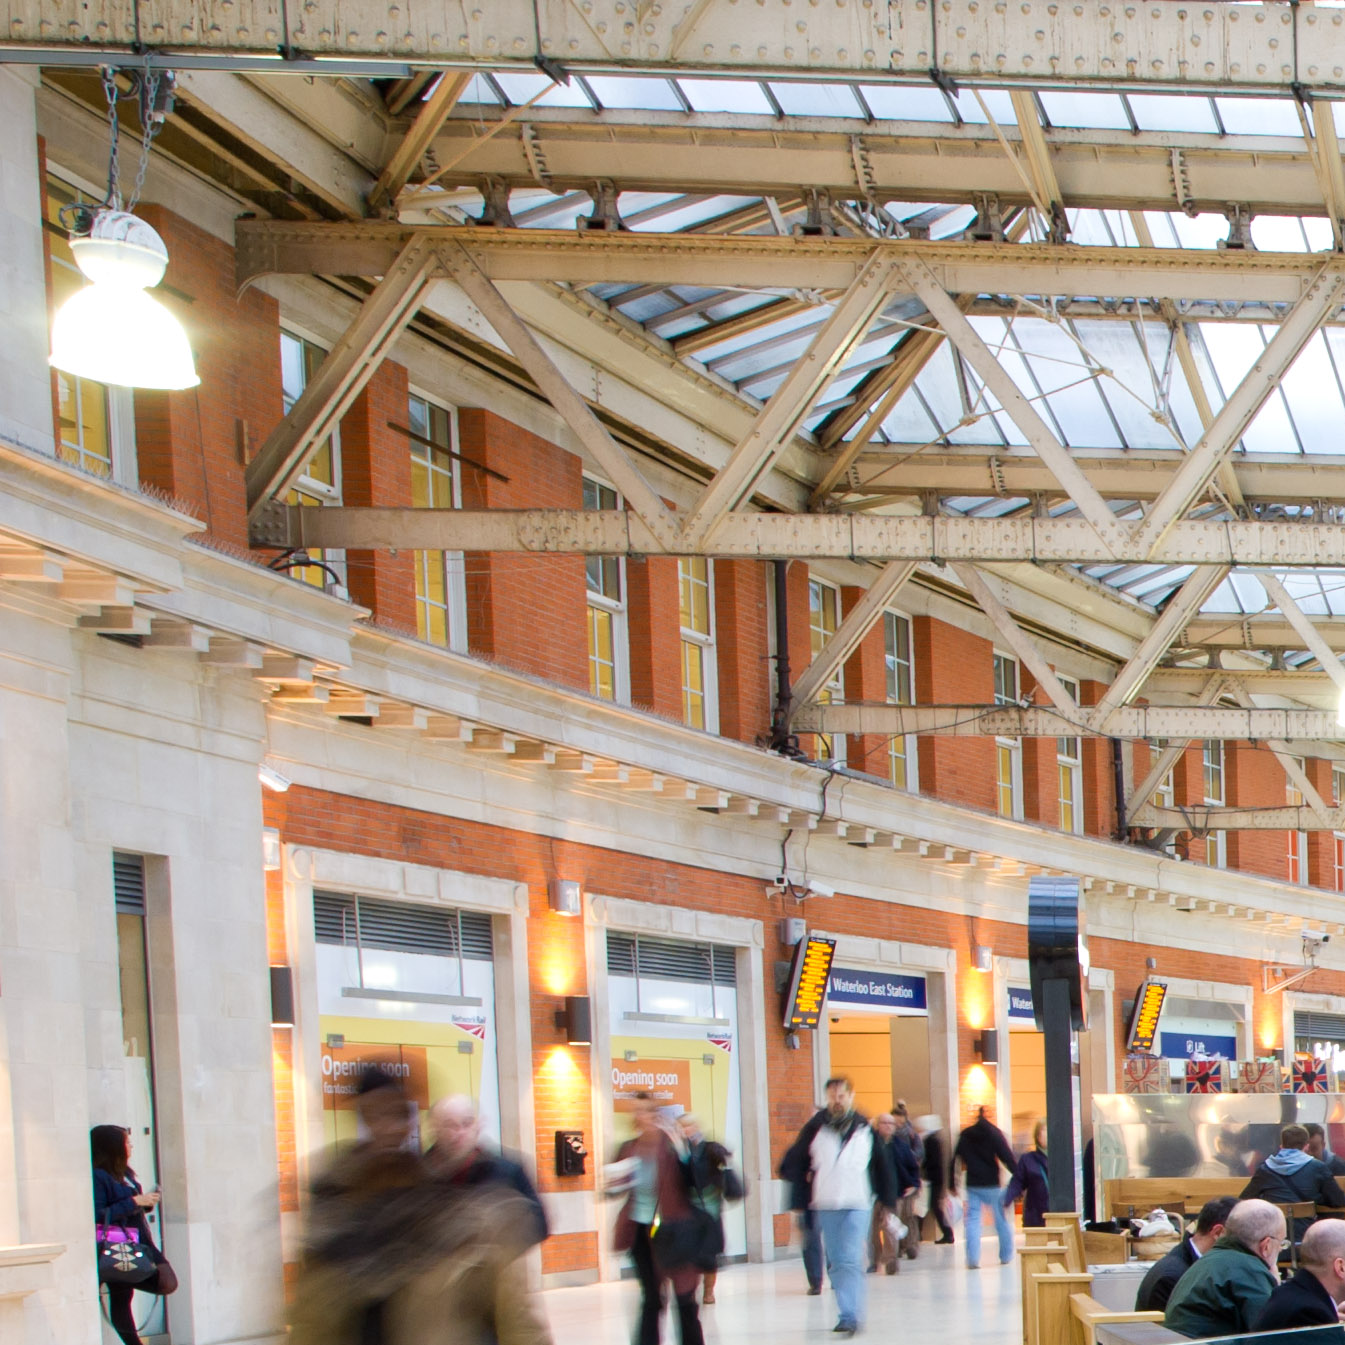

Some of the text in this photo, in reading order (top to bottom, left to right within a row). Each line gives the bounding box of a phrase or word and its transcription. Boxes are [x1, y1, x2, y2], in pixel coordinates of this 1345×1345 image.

[833, 977, 913, 999] Waterloo East Station
[612, 1068, 678, 1089] Opening soon
